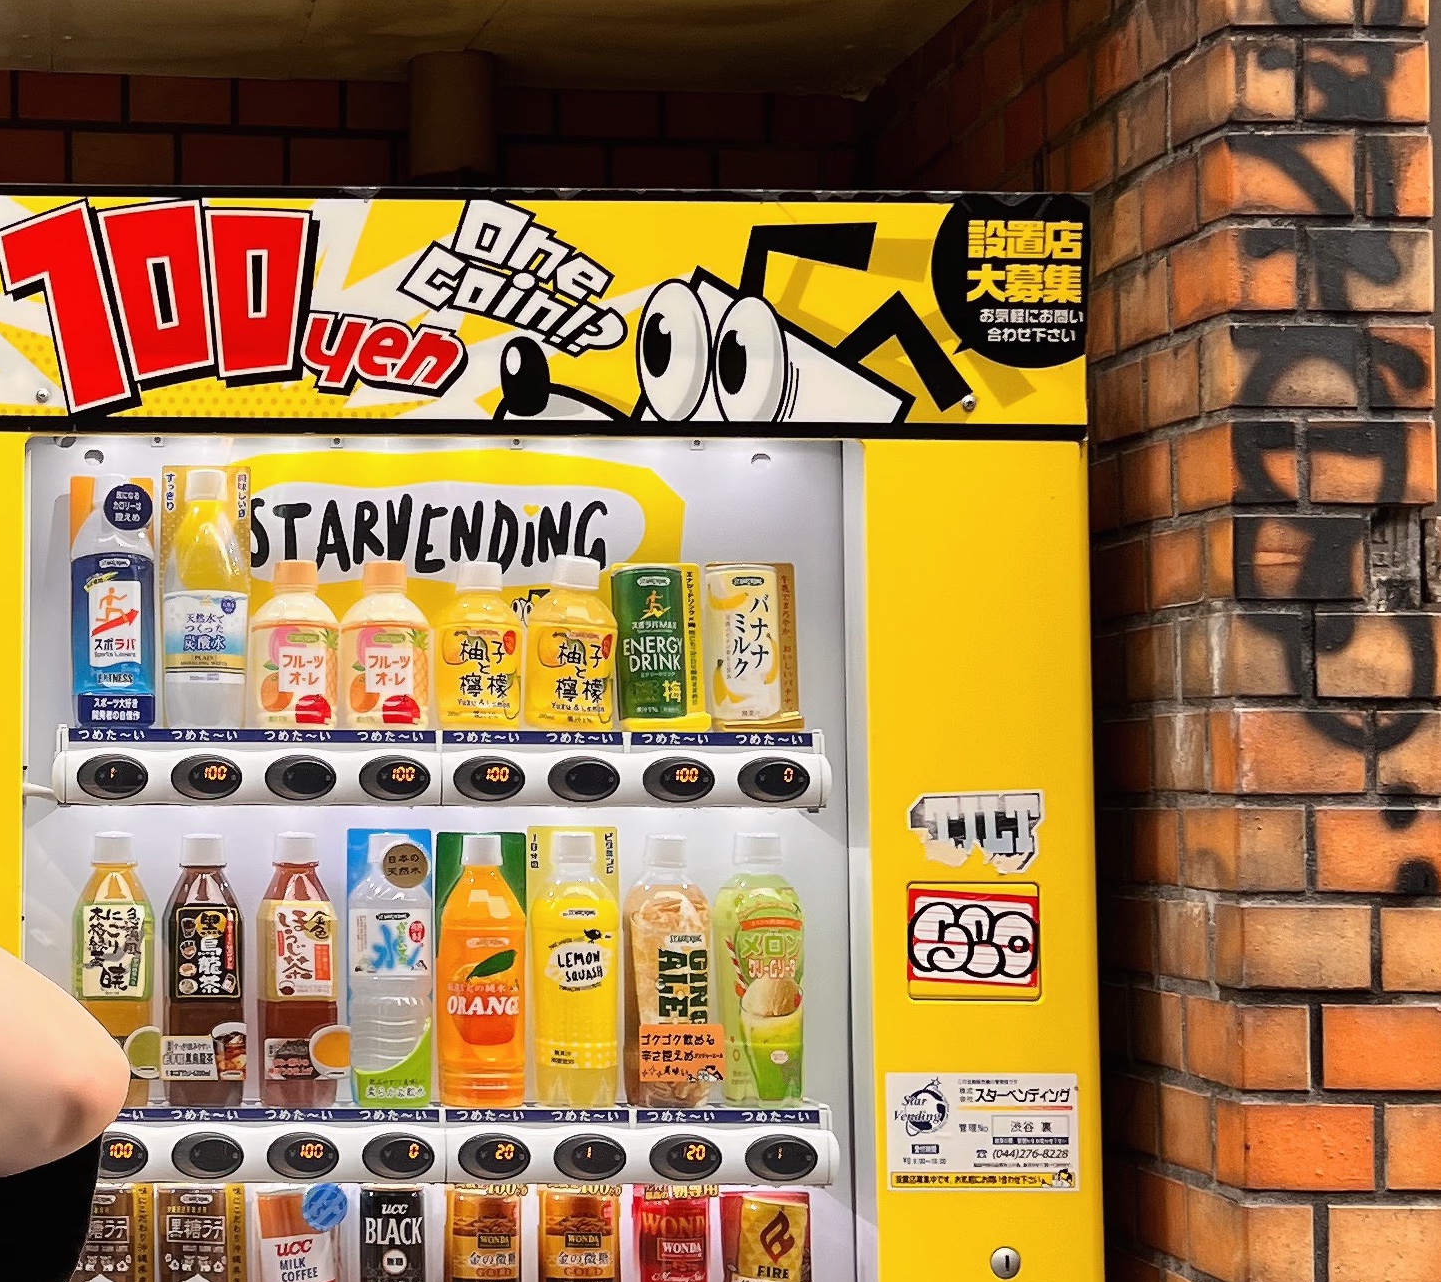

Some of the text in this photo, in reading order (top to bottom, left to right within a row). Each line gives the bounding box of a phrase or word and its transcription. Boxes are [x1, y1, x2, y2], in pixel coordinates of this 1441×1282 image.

[968, 220, 1083, 259] 設置店
[457, 197, 614, 300] One
[967, 264, 1082, 303] 大募集
[979, 308, 1084, 323] お気軽にお問い
[987, 327, 1076, 342] 合わせ下さい
[302, 312, 467, 394] yen
[750, 594, 769, 669] バナナ
[94, 638, 136, 651] スポラバ
[623, 637, 683, 655] ENERGY
[732, 613, 750, 679] ミルク
[282, 654, 324, 669] フルーツ
[369, 656, 410, 669] フルーツ
[628, 653, 682, 673] DRINK
[557, 950, 601, 969] LEMON
[565, 965, 604, 983] SQUASH
[658, 948, 689, 1017] ALE
[641, 1034, 715, 1046] ゴクゴク飲める
[902, 1095, 927, 1106] Star
[975, 1088, 1071, 1103] スターベンディング
[893, 1110, 943, 1123] Vending
[992, 1148, 1069, 1159] (044)276-8228
[381, 1204, 408, 1214] UCC
[169, 1219, 223, 1239] 黒糖ラテ
[365, 1217, 423, 1245] BLACK
[275, 1238, 313, 1257] UCC
[662, 1242, 701, 1253] WONDA
[279, 1257, 306, 1271] MILK
[281, 1266, 318, 1282] COFFEE
[476, 1268, 512, 1277] GOLD
[564, 1267, 603, 1277] GOLD
[758, 1266, 789, 1279] FIRE
